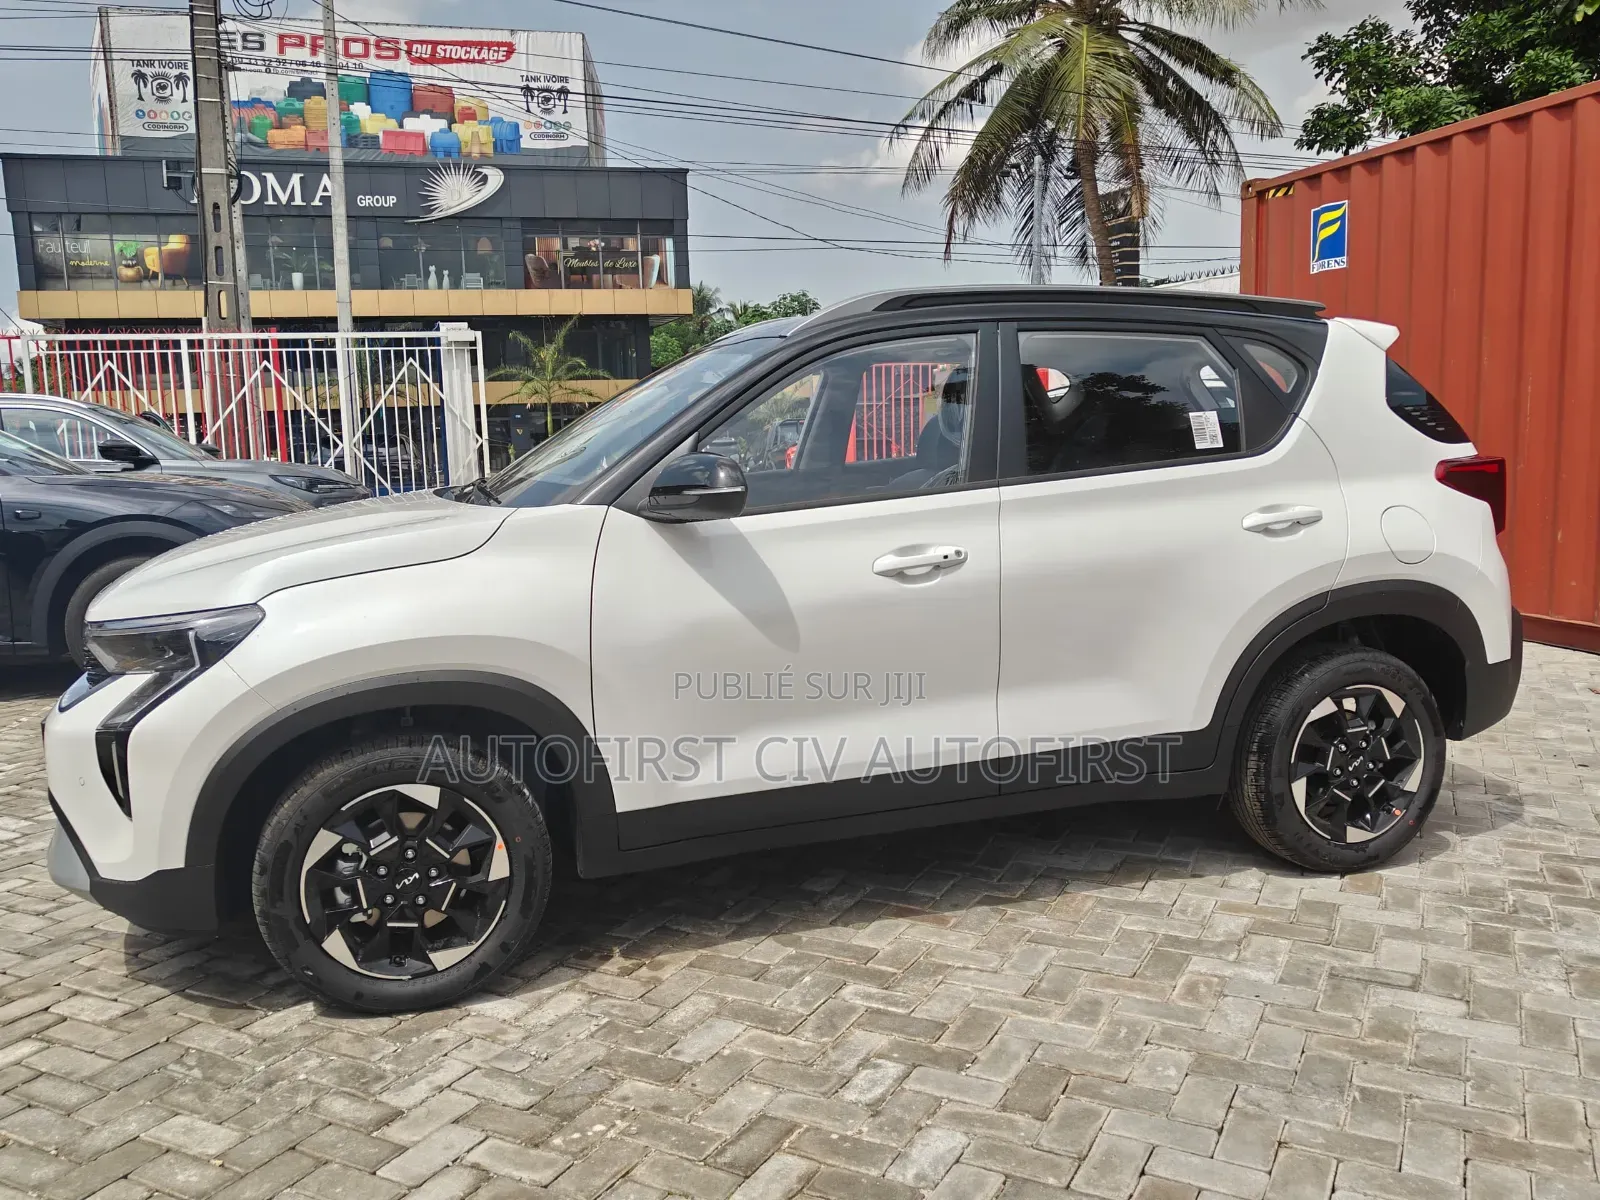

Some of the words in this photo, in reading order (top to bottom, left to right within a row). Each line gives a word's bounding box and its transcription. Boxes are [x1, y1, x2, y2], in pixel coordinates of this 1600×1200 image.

[277, 32, 401, 61] PROS
[411, 43, 432, 58] DU
[435, 45, 508, 60] STOCKAGE
[131, 59, 156, 69] TANK
[158, 60, 189, 70] IVOIRE
[520, 74, 542, 83] TANK
[544, 75, 570, 84] IVOIRE
[356, 195, 397, 207] GROUP
[69, 255, 110, 266] moderne
[563, 257, 600, 268] Meubles
[603, 259, 614, 268] de
[614, 256, 638, 269] Luxe
